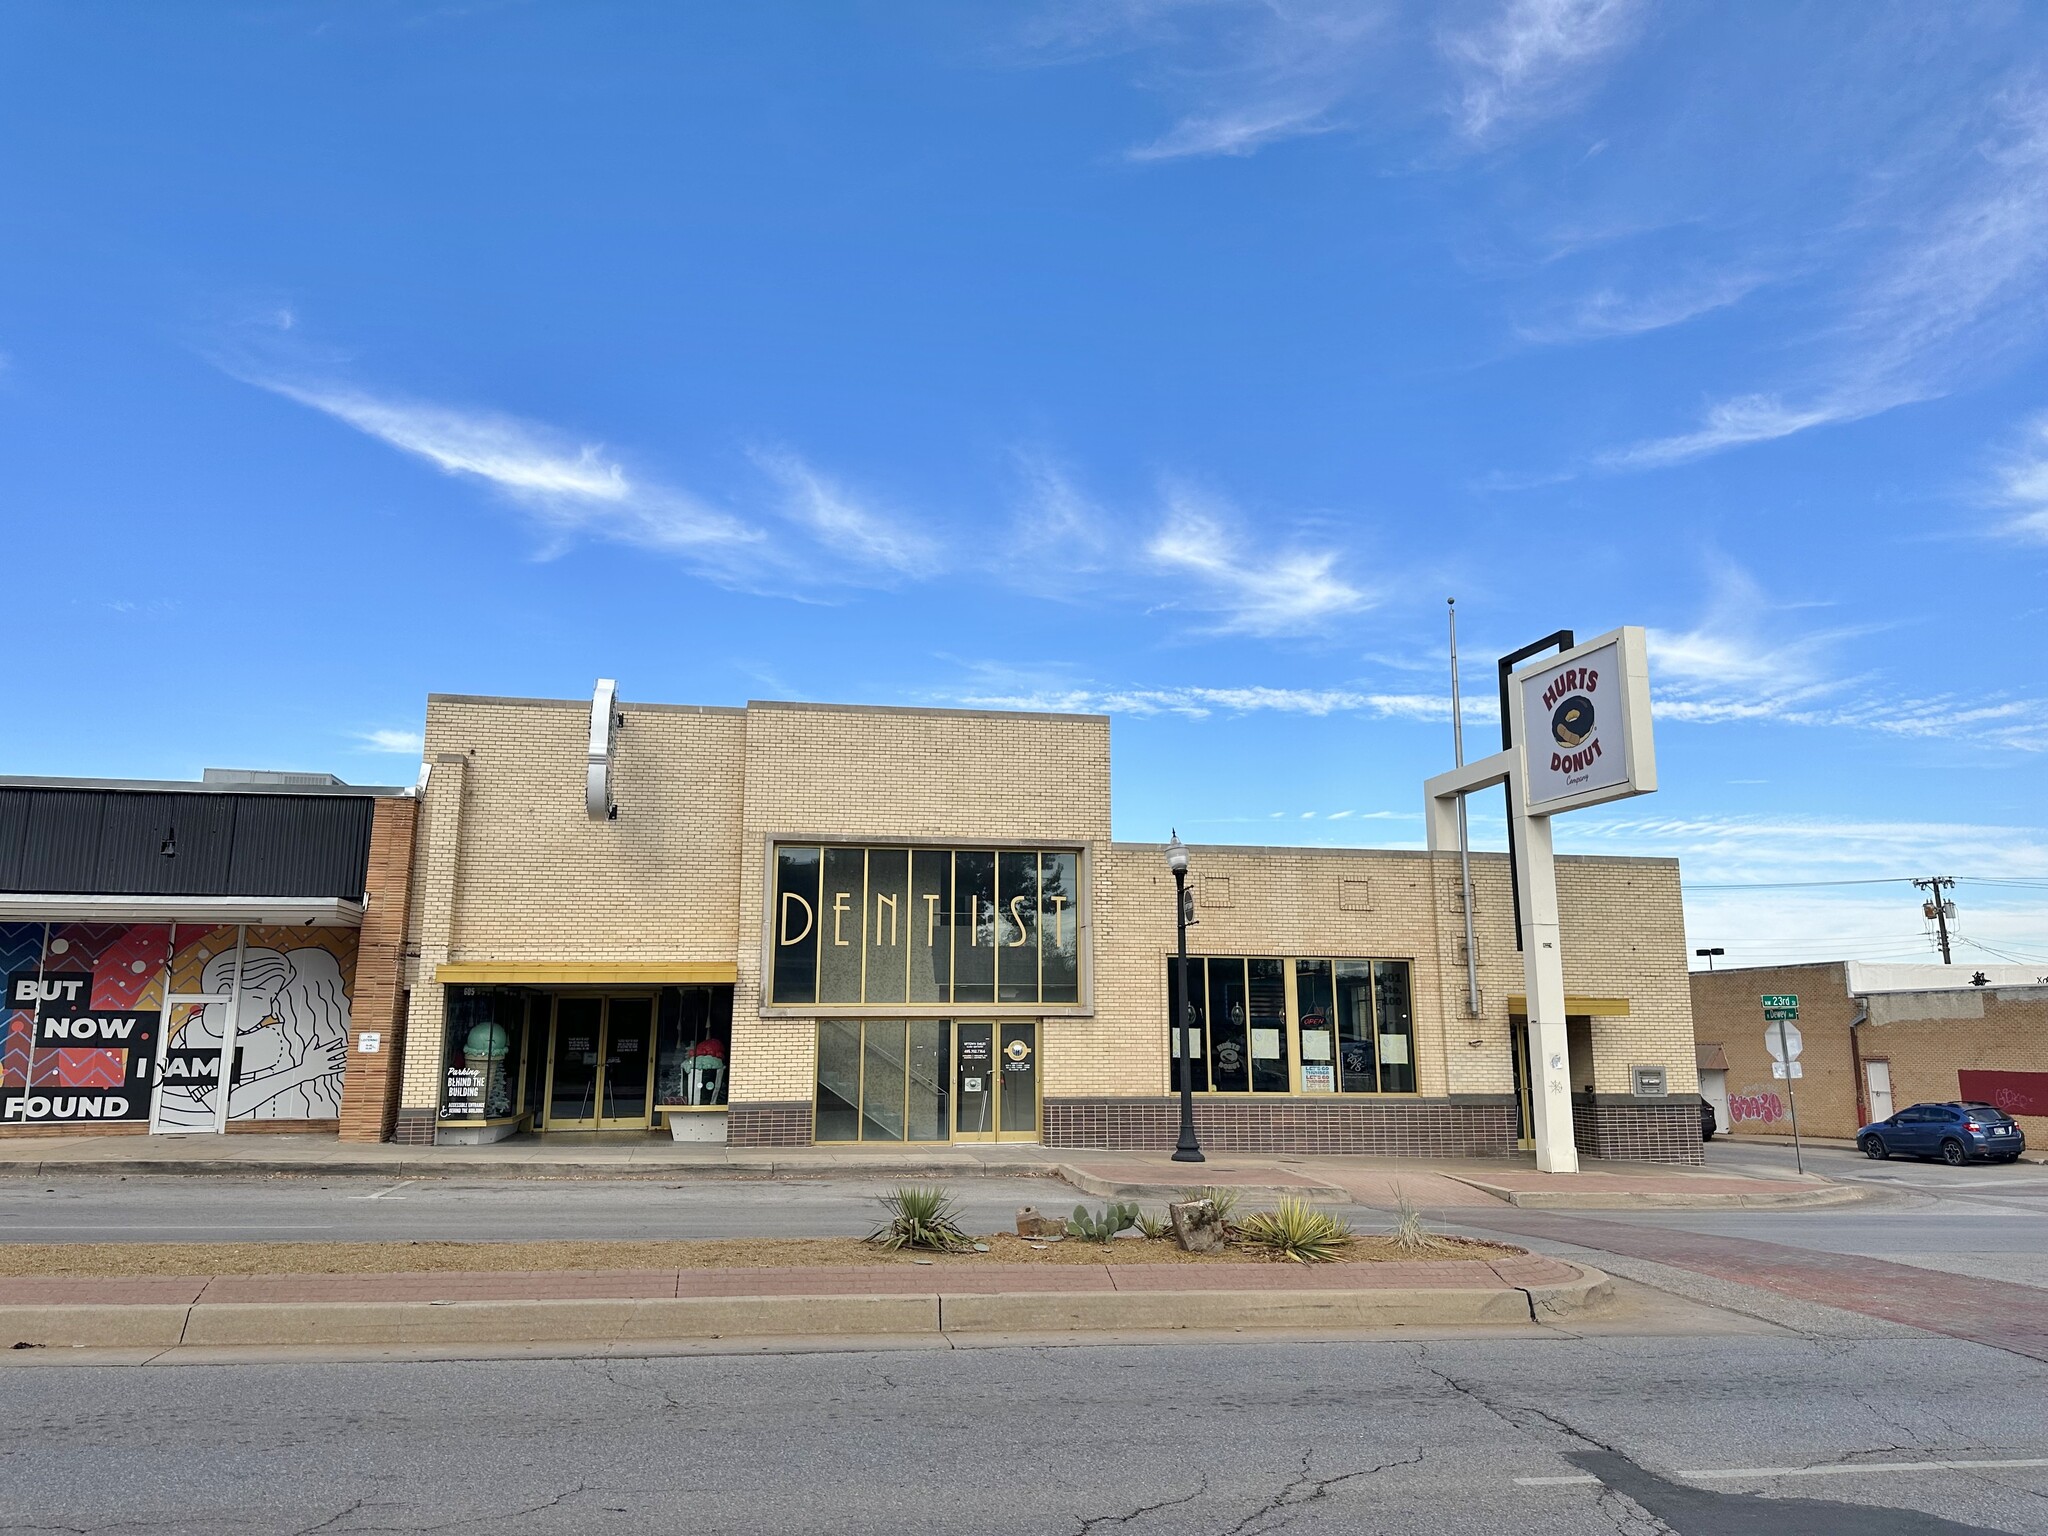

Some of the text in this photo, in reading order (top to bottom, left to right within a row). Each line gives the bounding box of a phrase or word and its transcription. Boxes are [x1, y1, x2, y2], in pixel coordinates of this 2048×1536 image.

[1542, 667, 1599, 712] HURTS
[1550, 737, 1602, 774] DONUT
[1566, 774, 1589, 786] Company
[780, 892, 1067, 948] DENTIST
[15, 980, 84, 1001] BUT
[1772, 996, 1790, 1006] 23rd
[1770, 1010, 1787, 1020] Dewey
[44, 1017, 136, 1039] NOW
[136, 1057, 220, 1079] I AM
[447, 1067, 481, 1078] Parking
[447, 1077, 485, 1086] BEHIND THE
[448, 1087, 479, 1097] BUILDING
[3, 1096, 129, 1118] FOUND
